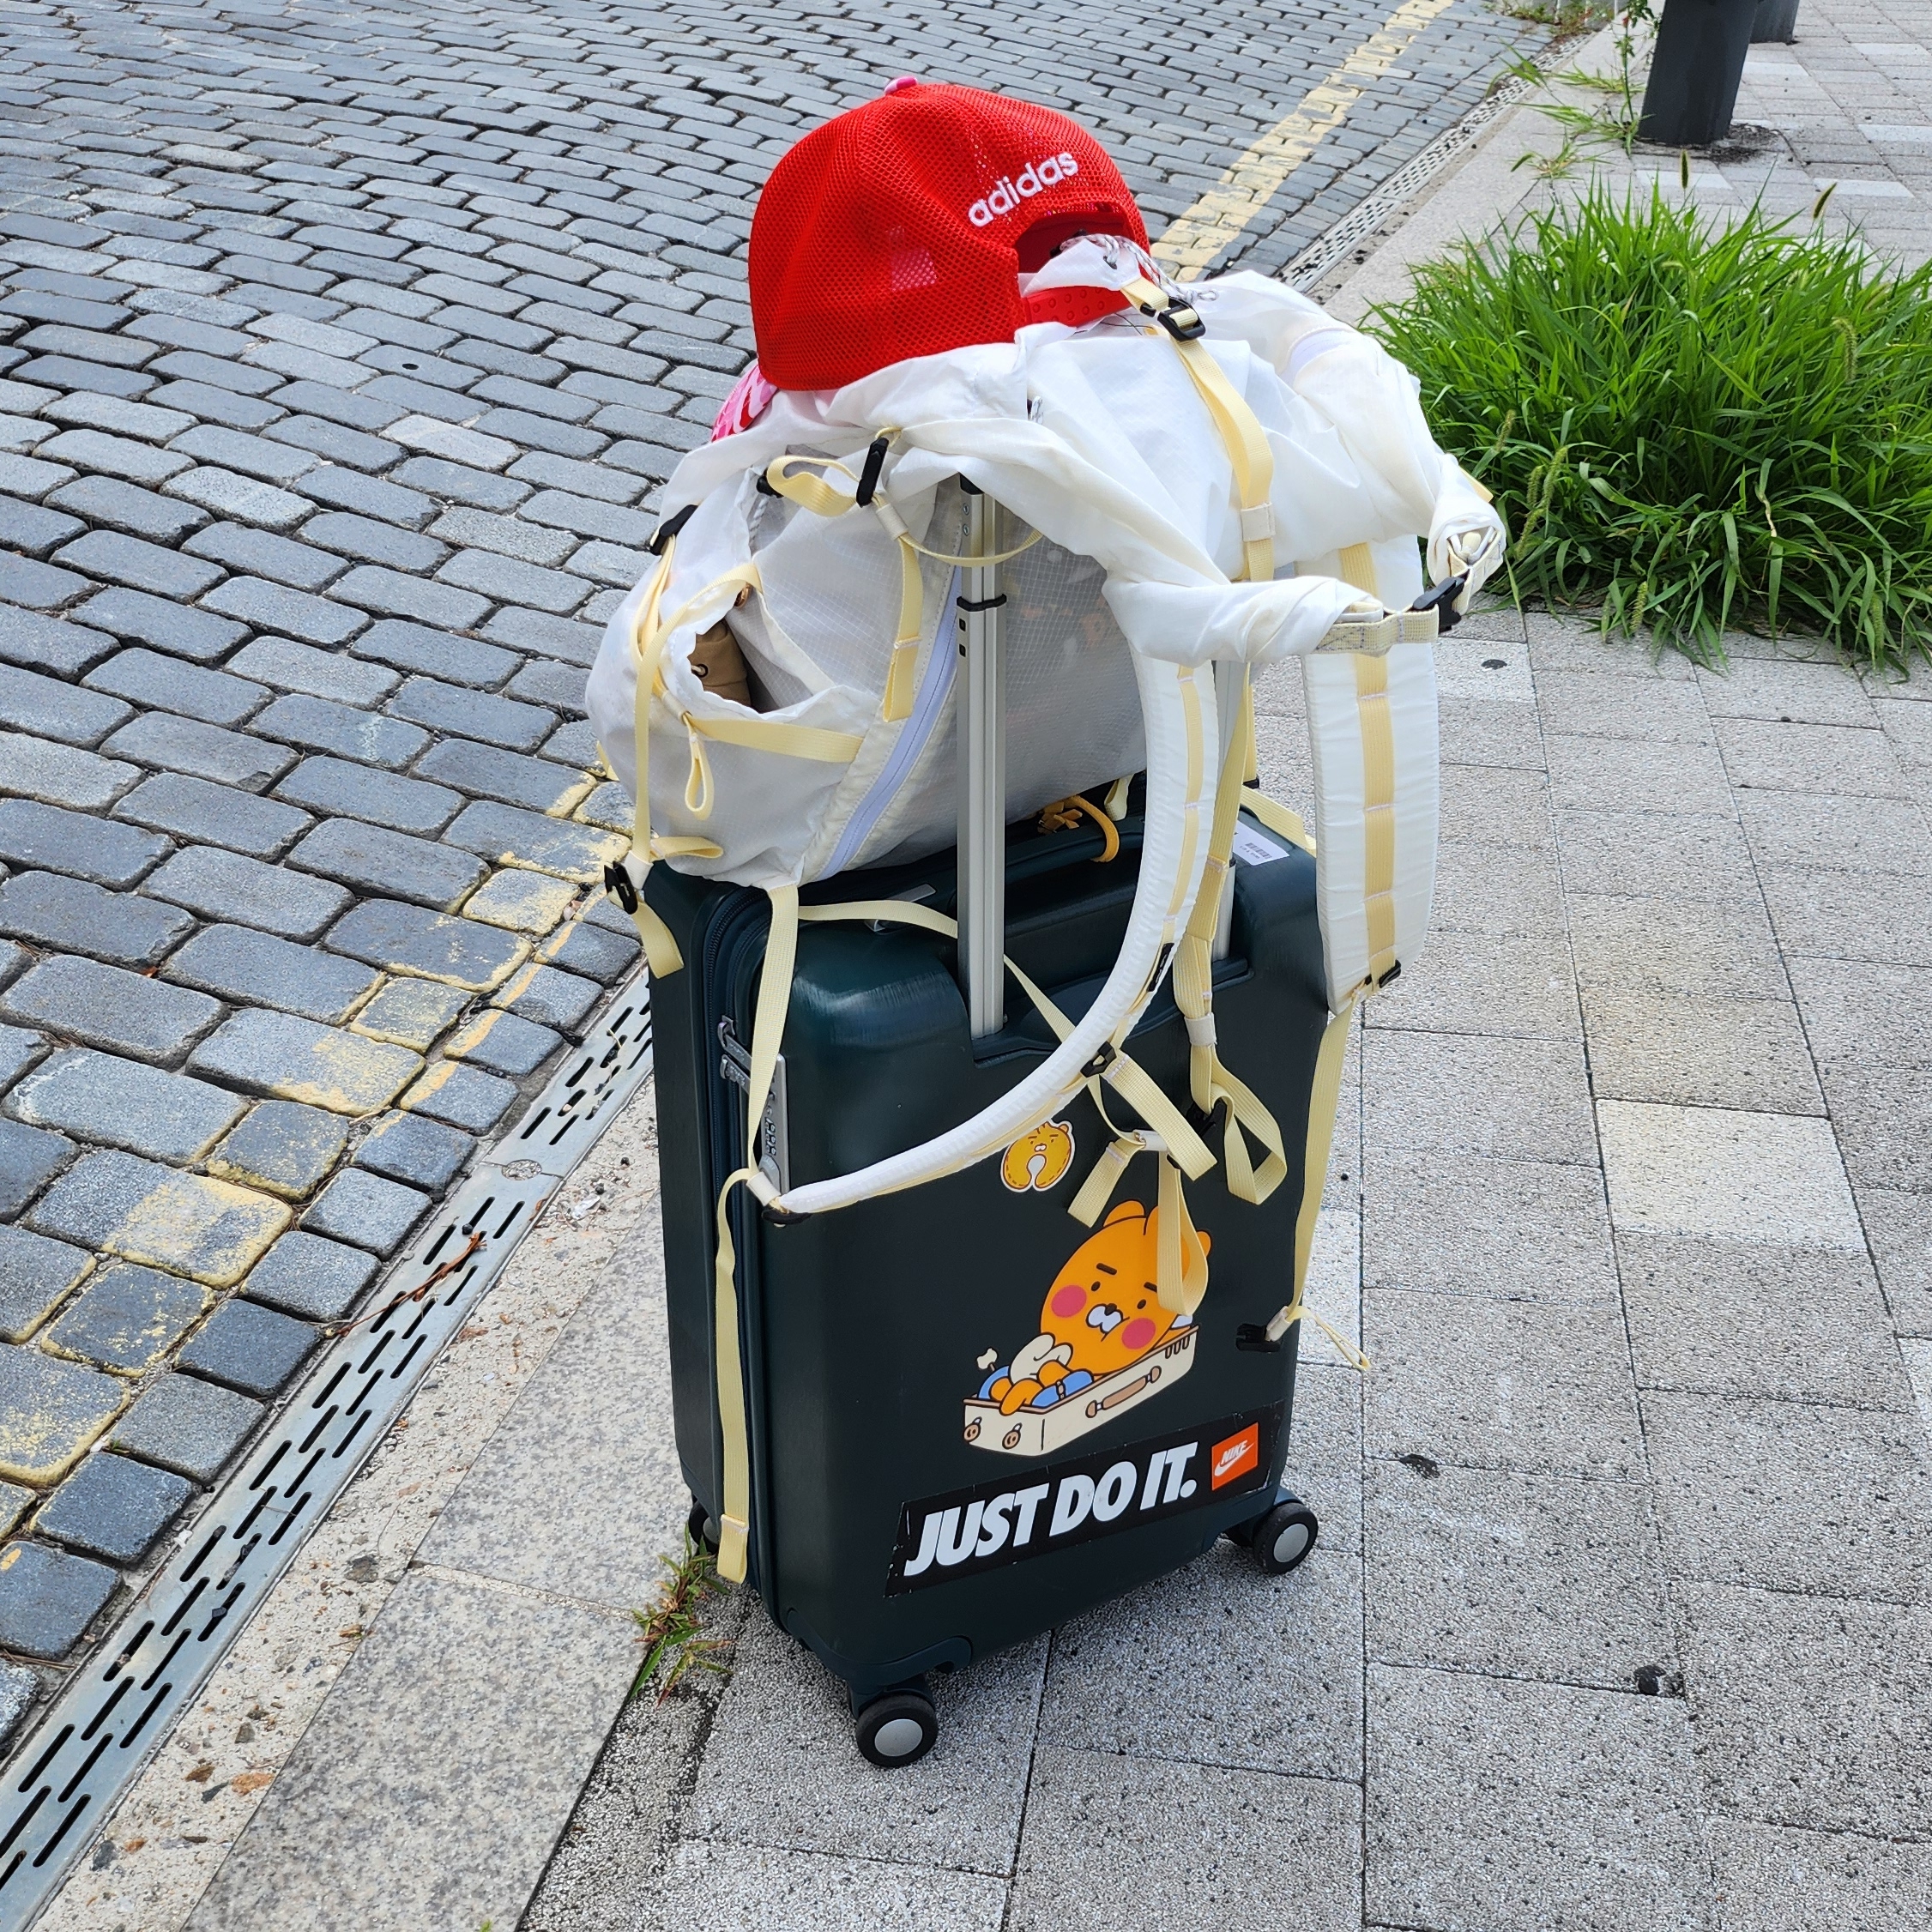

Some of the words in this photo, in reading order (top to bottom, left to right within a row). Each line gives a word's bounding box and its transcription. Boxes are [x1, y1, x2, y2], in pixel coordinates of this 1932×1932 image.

[968, 151, 1079, 228] adidas
[1220, 1440, 1248, 1465] NIKE
[903, 1483, 1050, 1577] JUST
[1048, 1461, 1138, 1537] DO
[1139, 1441, 1198, 1511] IT.
